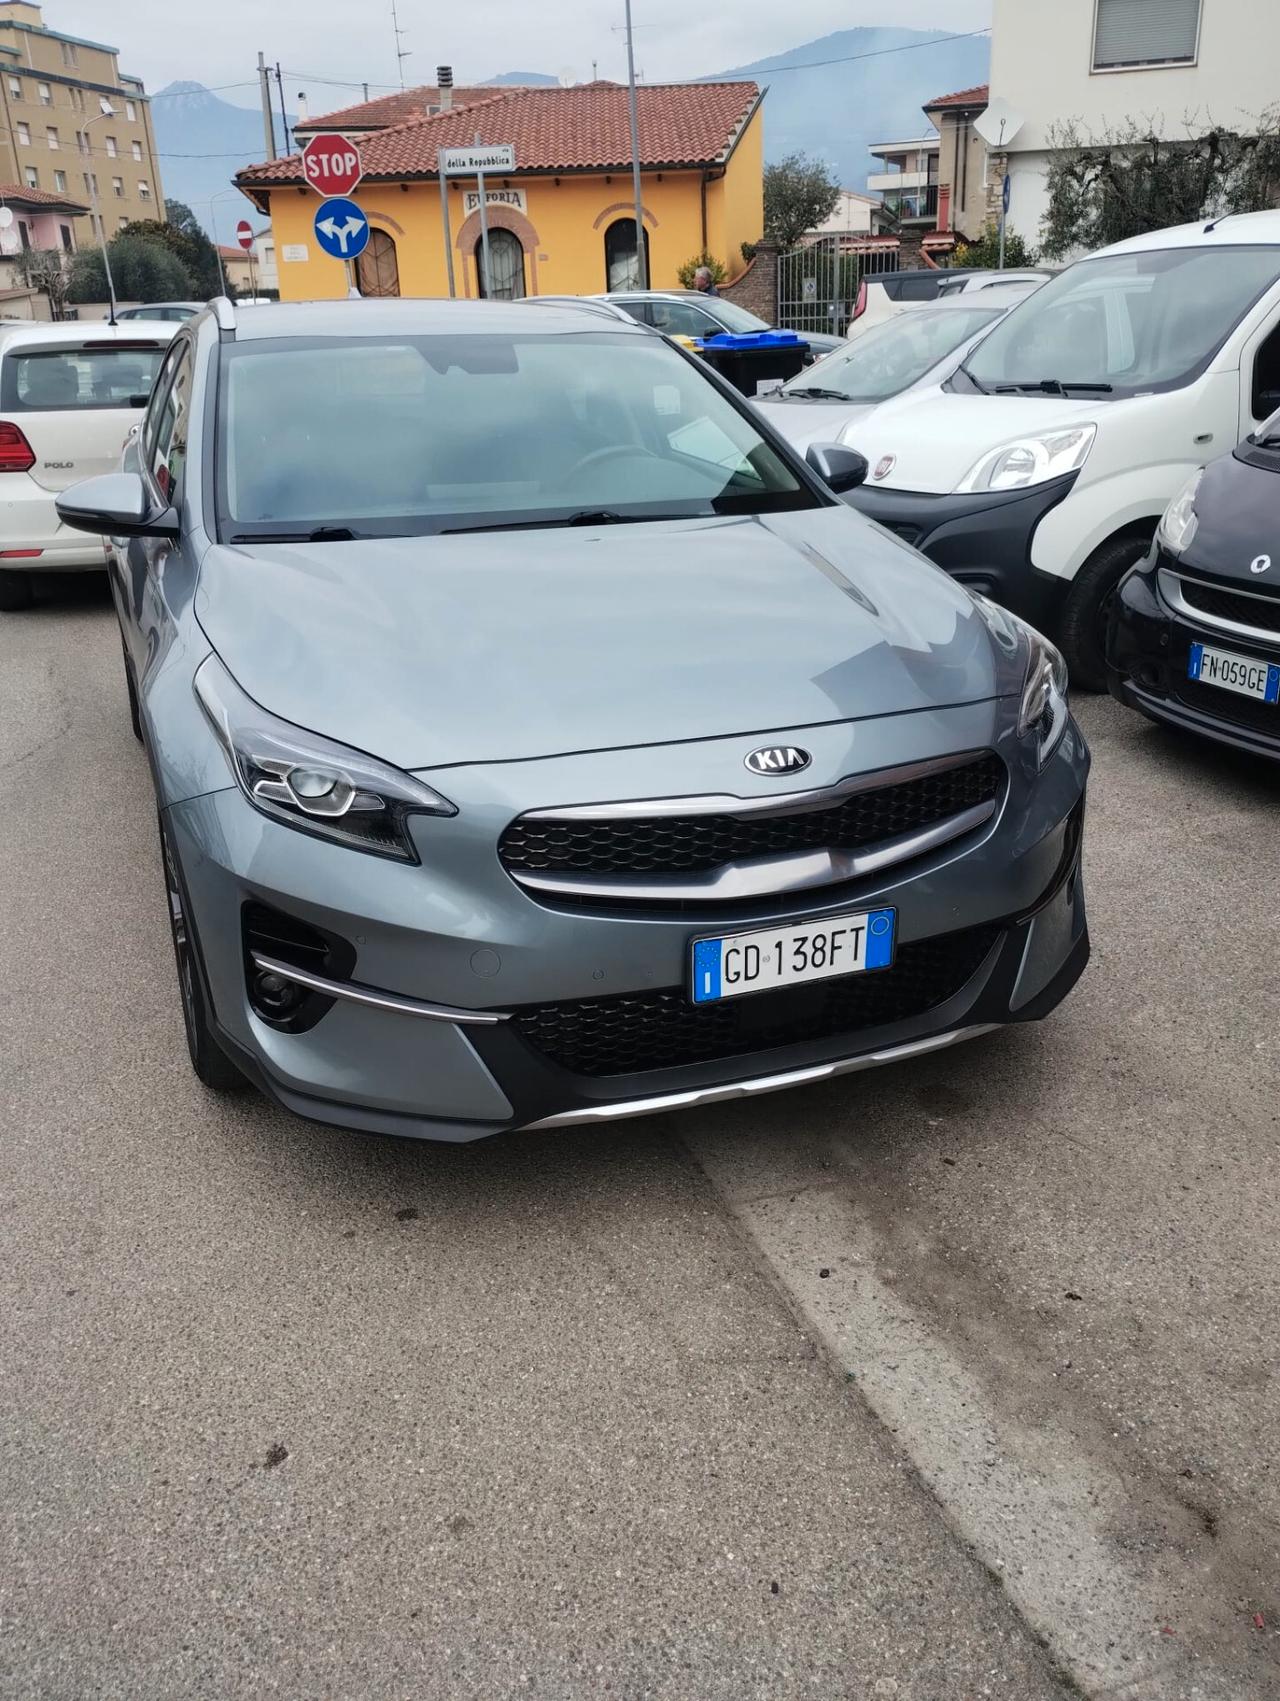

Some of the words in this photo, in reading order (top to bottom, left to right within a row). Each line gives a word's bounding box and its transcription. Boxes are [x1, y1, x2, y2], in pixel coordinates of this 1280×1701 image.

[306, 152, 357, 177] STOP
[447, 158, 466, 168] della
[469, 156, 510, 168] Repubblica
[755, 748, 805, 770] KIA
